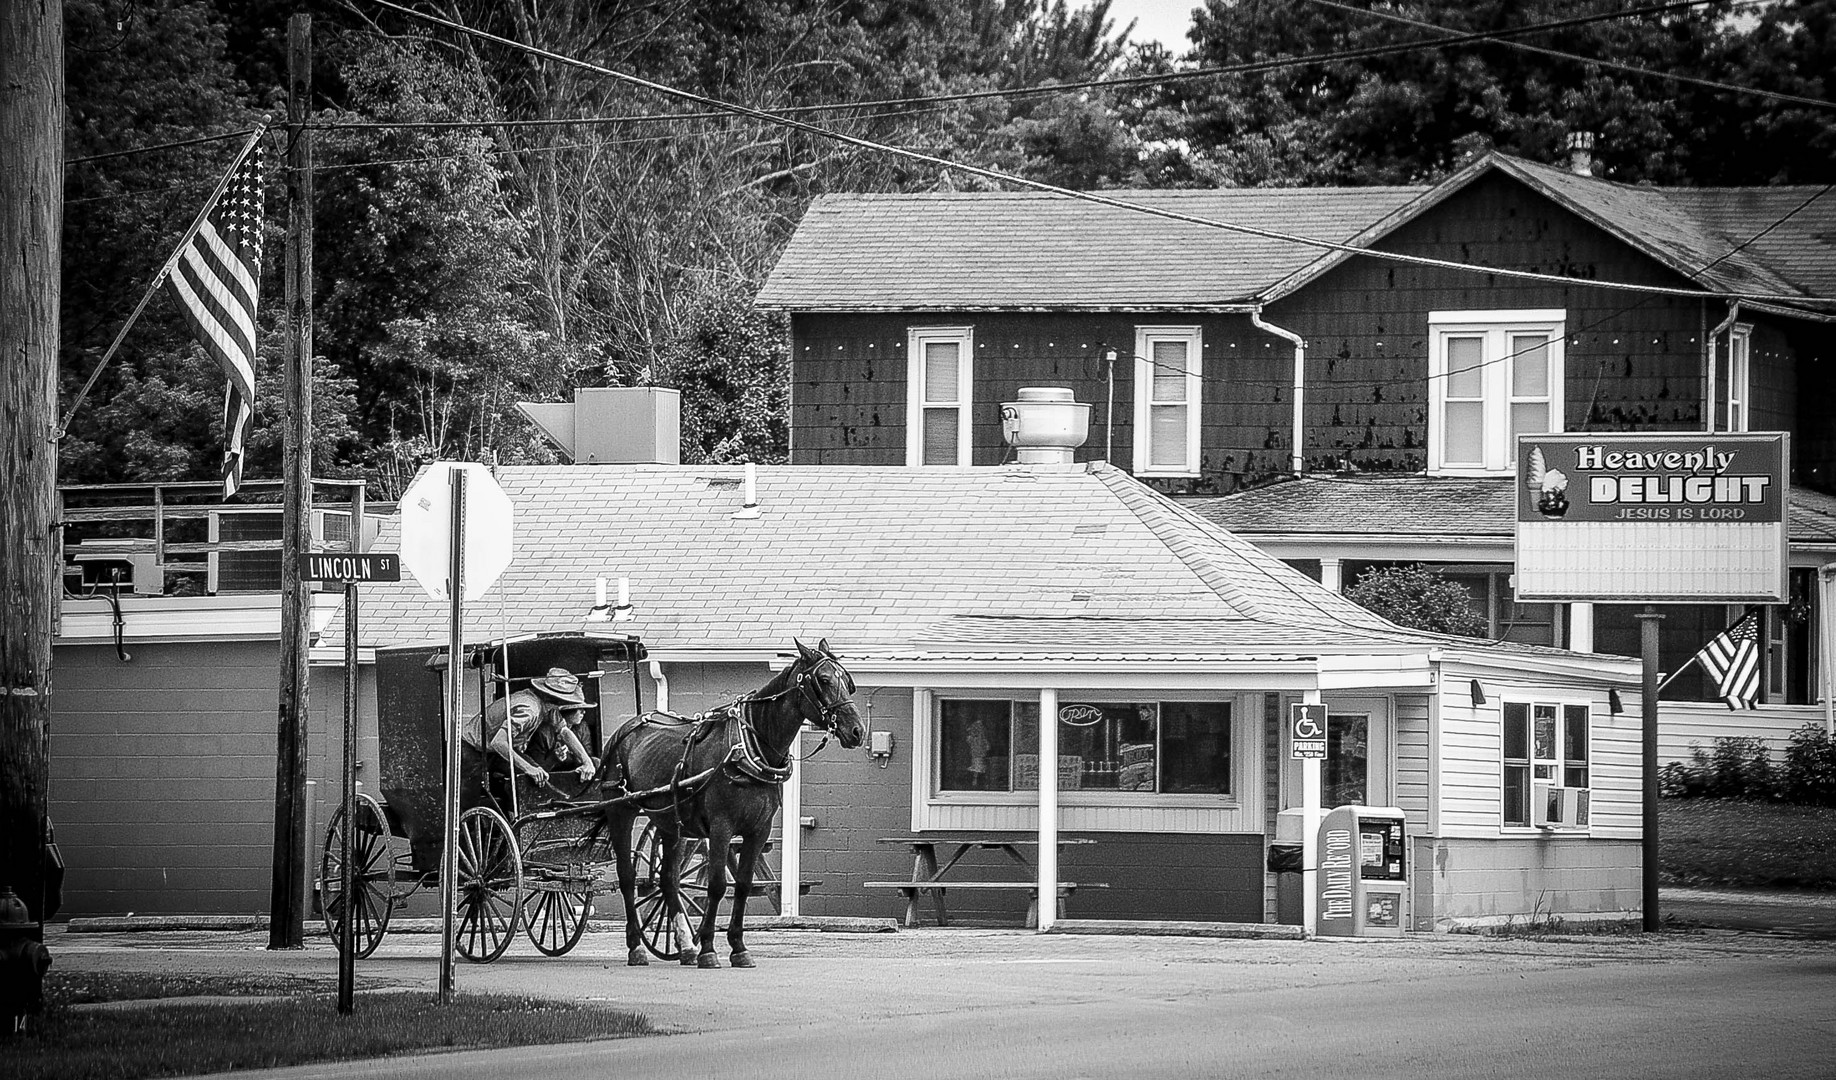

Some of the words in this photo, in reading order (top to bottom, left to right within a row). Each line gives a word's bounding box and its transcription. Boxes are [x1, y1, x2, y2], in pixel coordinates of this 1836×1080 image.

[1575, 445, 1736, 475] Heavenly
[1589, 476, 1770, 503] DELIGHT
[1615, 508, 1671, 519] JESUS
[1677, 508, 1694, 519] IS
[1700, 508, 1745, 519] LORD
[309, 557, 371, 579] LINCOLN
[380, 558, 390, 570] ST
[1294, 741, 1325, 751] PARKING
